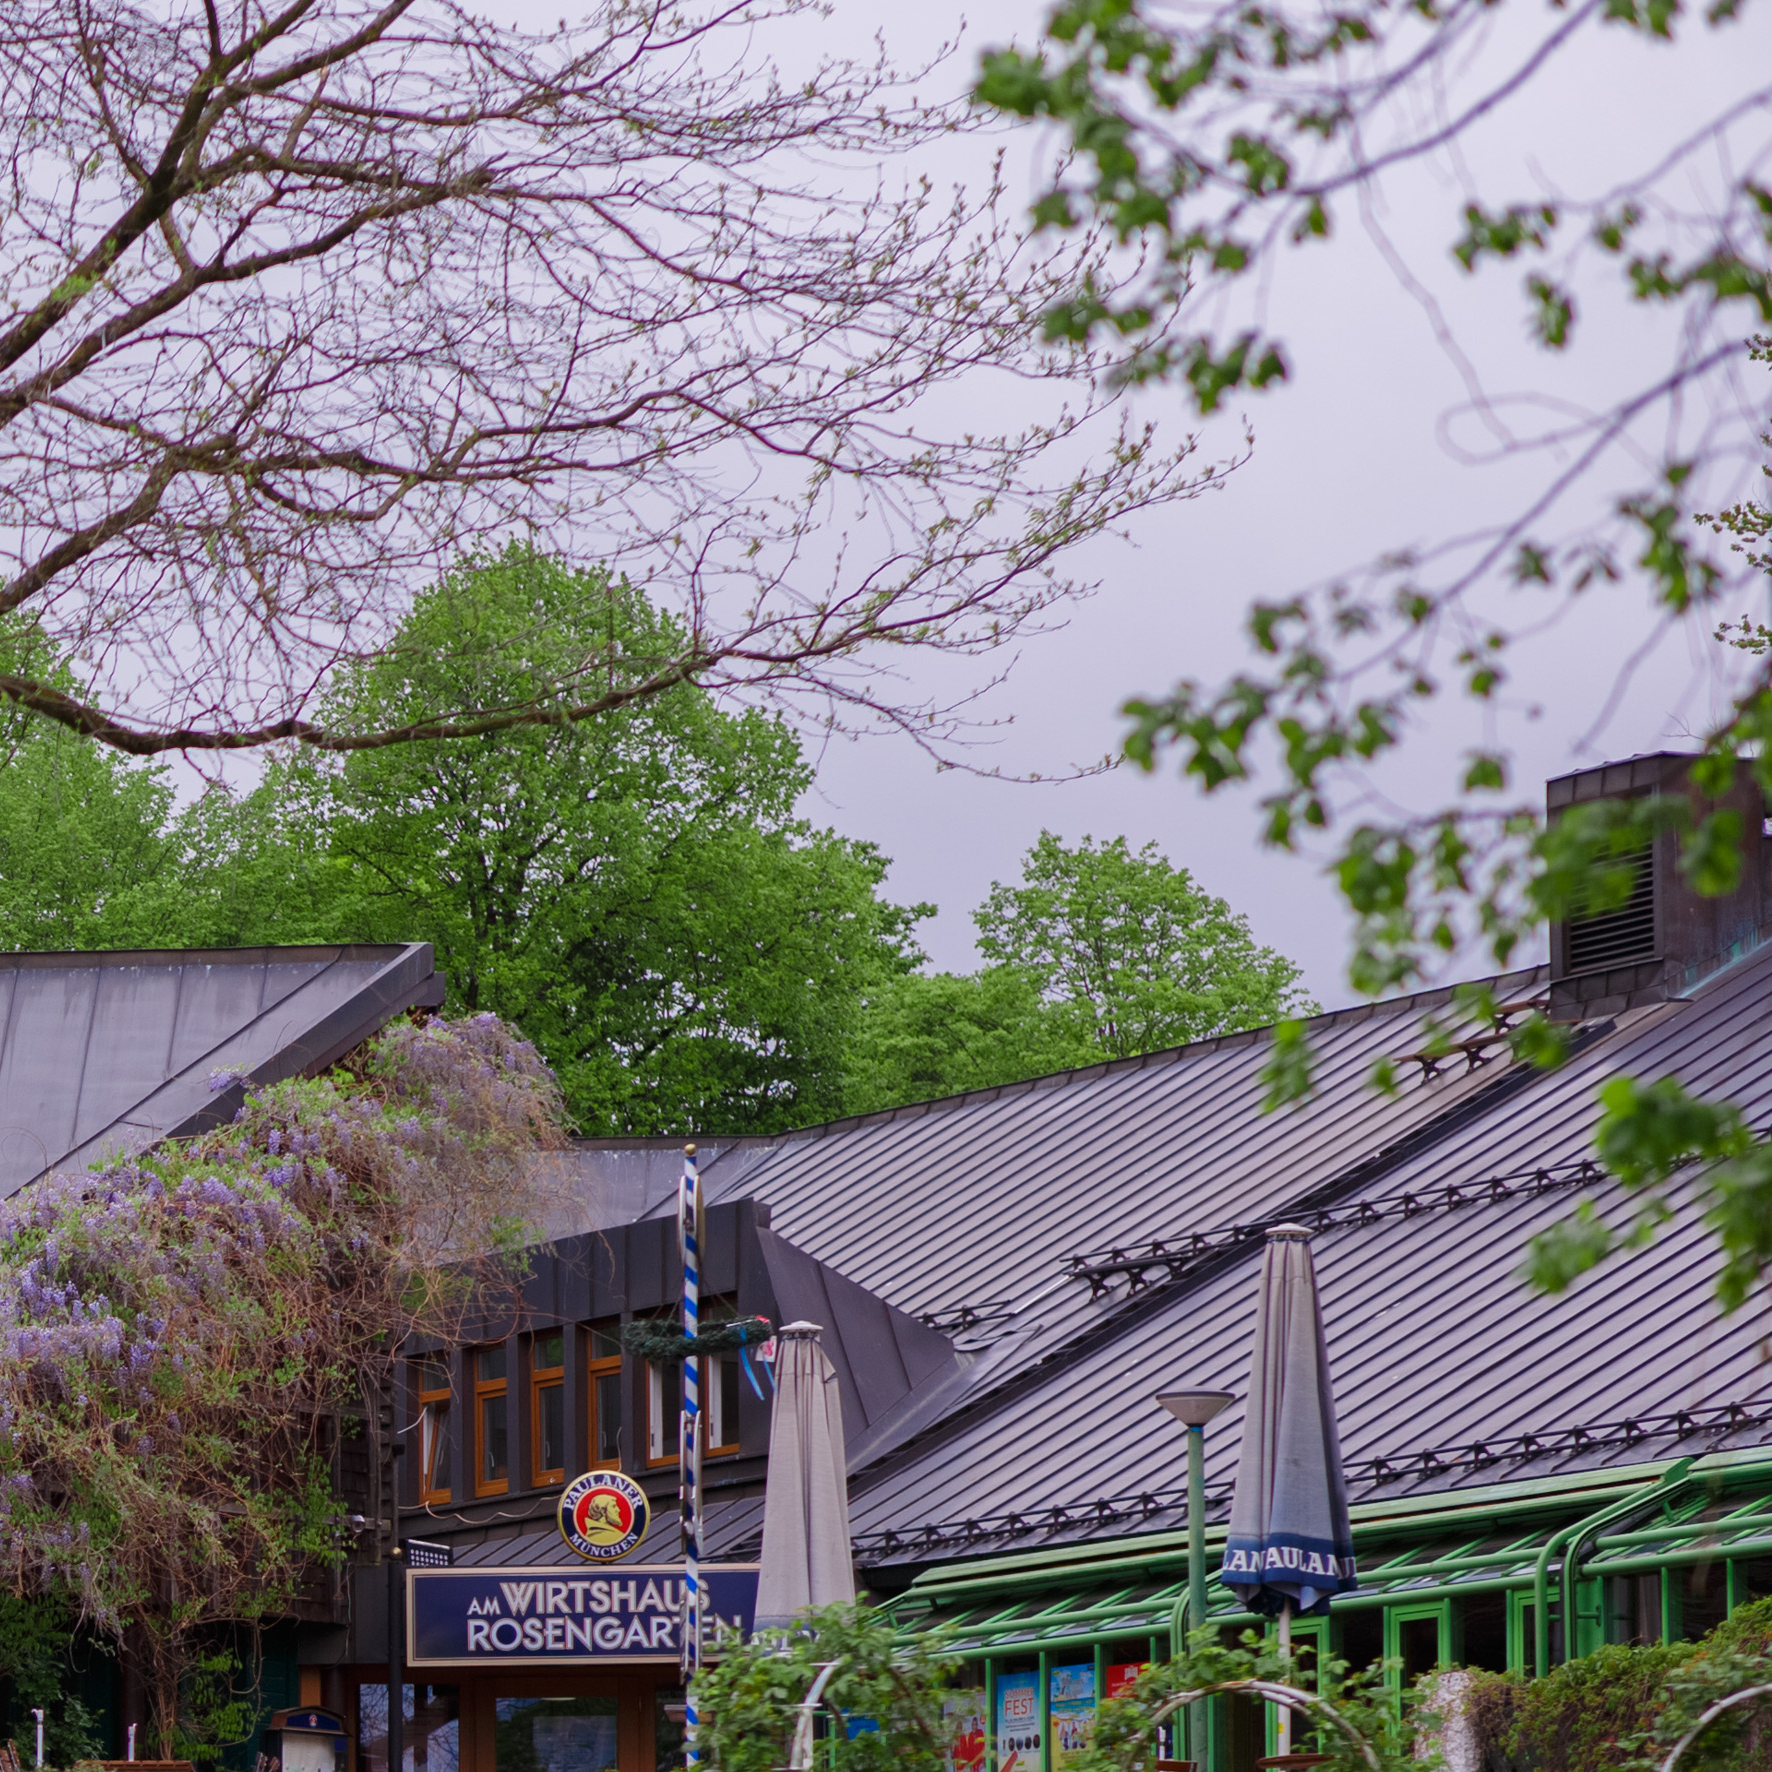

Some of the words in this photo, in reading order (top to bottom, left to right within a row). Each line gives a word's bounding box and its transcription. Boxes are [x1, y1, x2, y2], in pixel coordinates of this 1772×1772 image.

[562, 1474, 644, 1511] PAULANER
[466, 1596, 502, 1616] AM
[499, 1578, 711, 1616] WIRTSHAUS
[466, 1613, 742, 1652] ROSENGAREN
[1004, 1697, 1034, 1717] FEST
